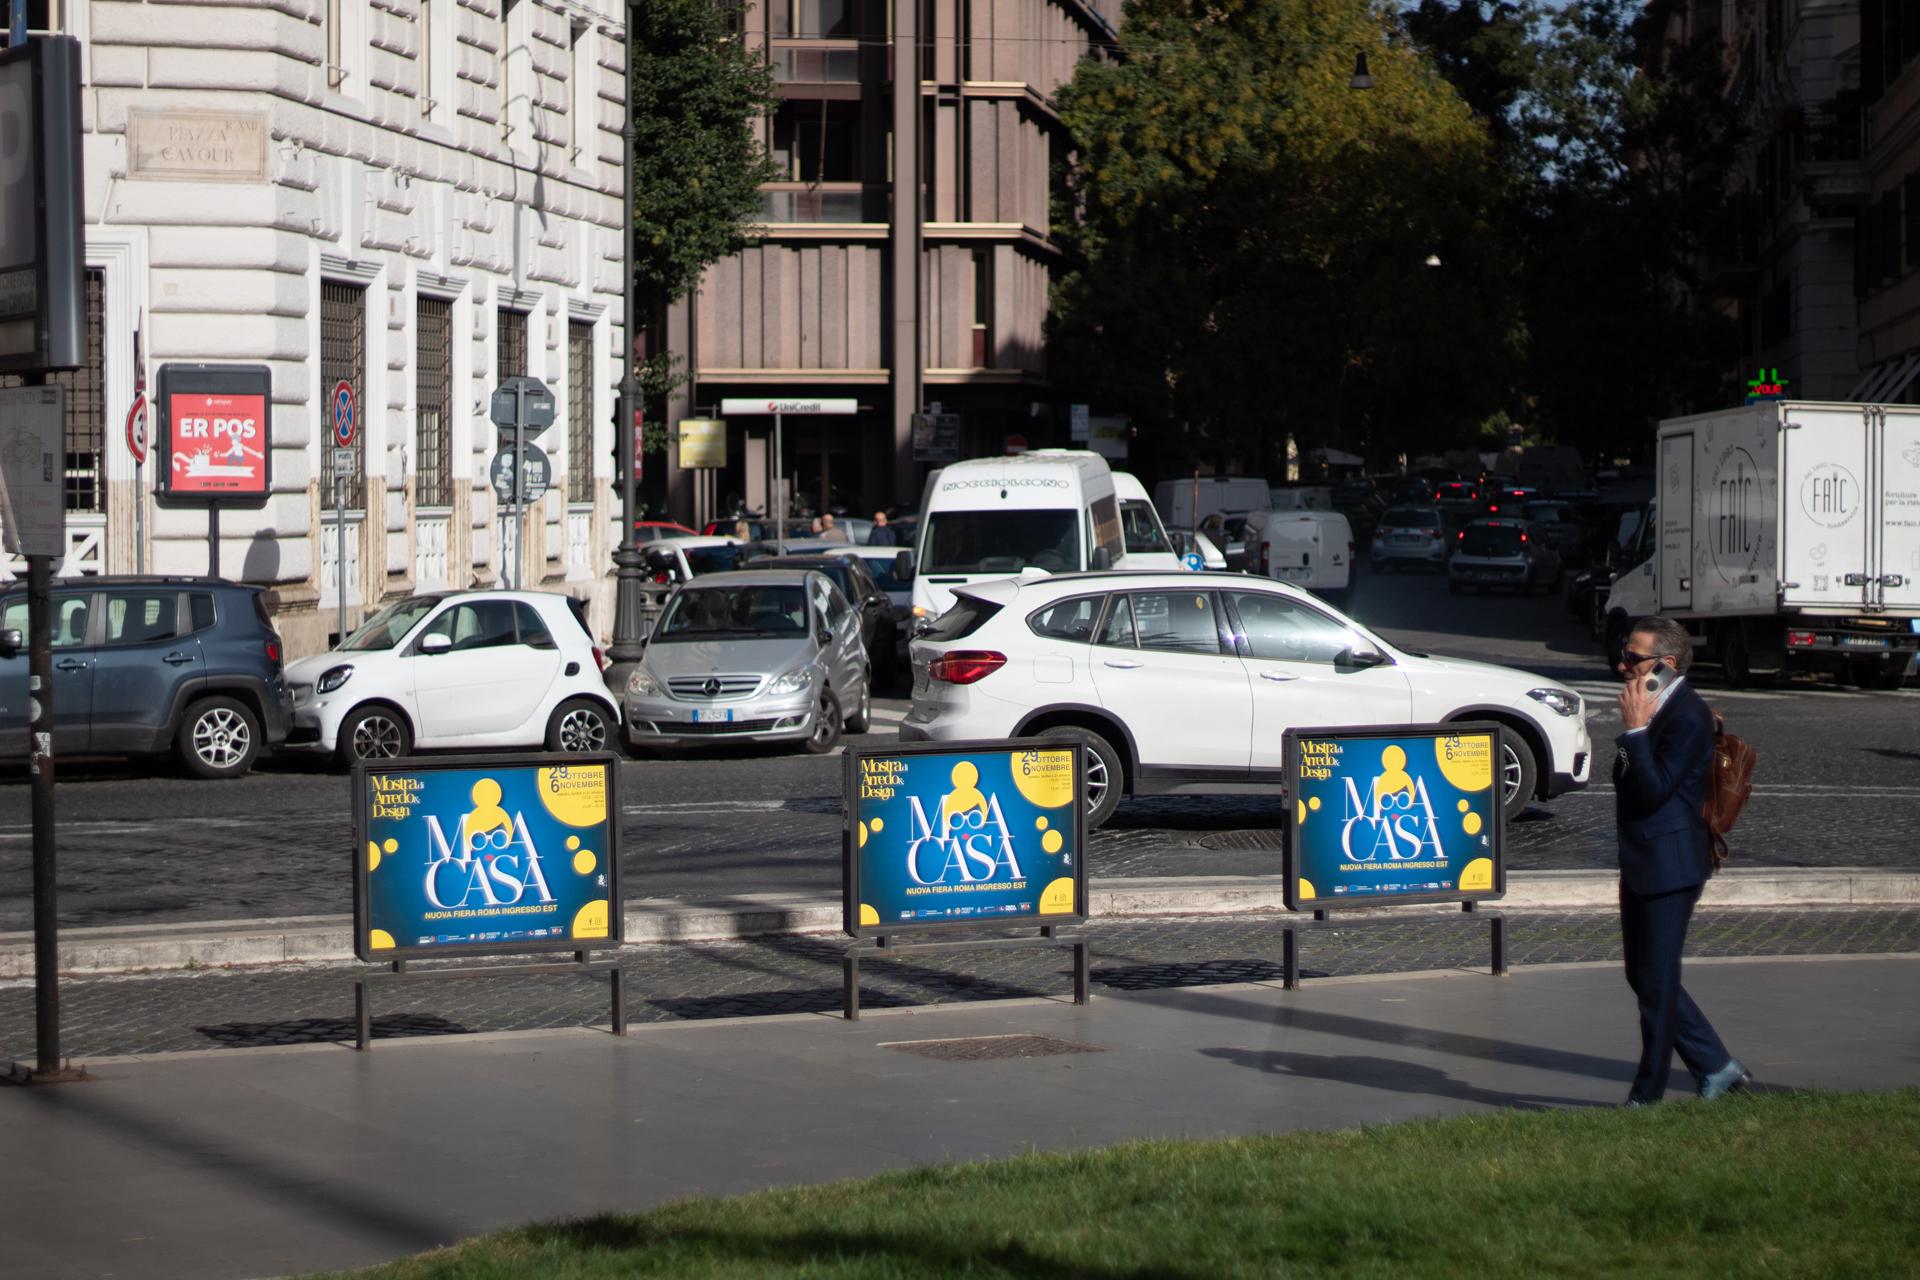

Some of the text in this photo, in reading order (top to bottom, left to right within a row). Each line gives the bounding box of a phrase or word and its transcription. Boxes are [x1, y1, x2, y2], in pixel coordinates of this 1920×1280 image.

[169, 126, 227, 141] PIAZZA
[161, 147, 235, 162] CAVOUR
[780, 403, 821, 413] UniCredit
[179, 417, 256, 439] ER POS
[1813, 472, 1847, 513] FAIC
[1719, 463, 1751, 554] FAIC
[1300, 740, 1337, 754] Mostra
[1446, 748, 1453, 760] 6
[861, 759, 902, 773] Mostra
[1037, 755, 1071, 763] OTTOBRE
[1302, 753, 1336, 766] Arredo
[549, 766, 604, 780] 29 OTTOBRE
[1022, 763, 1070, 775] 6 NOVEMBRE
[1300, 765, 1332, 780] Design
[372, 776, 417, 791] Mostra
[862, 770, 899, 785] Arredo
[551, 779, 560, 793] 6
[560, 781, 604, 789] NOVEMBRE
[861, 784, 895, 800] Design
[374, 789, 414, 804] Arredo
[373, 803, 410, 820] Design
[1342, 815, 1448, 861] CASA
[908, 834, 1027, 884] CASA
[1340, 863, 1362, 871] NUOVA
[1402, 861, 1434, 869] INGRESSO
[1436, 860, 1448, 868] EST
[426, 854, 558, 908] CASA
[906, 881, 1027, 896] NUOVA FIERA ROMA INGRESSO EST
[425, 904, 558, 920] NUOVA FIERA ROMA INGRESSO EST
